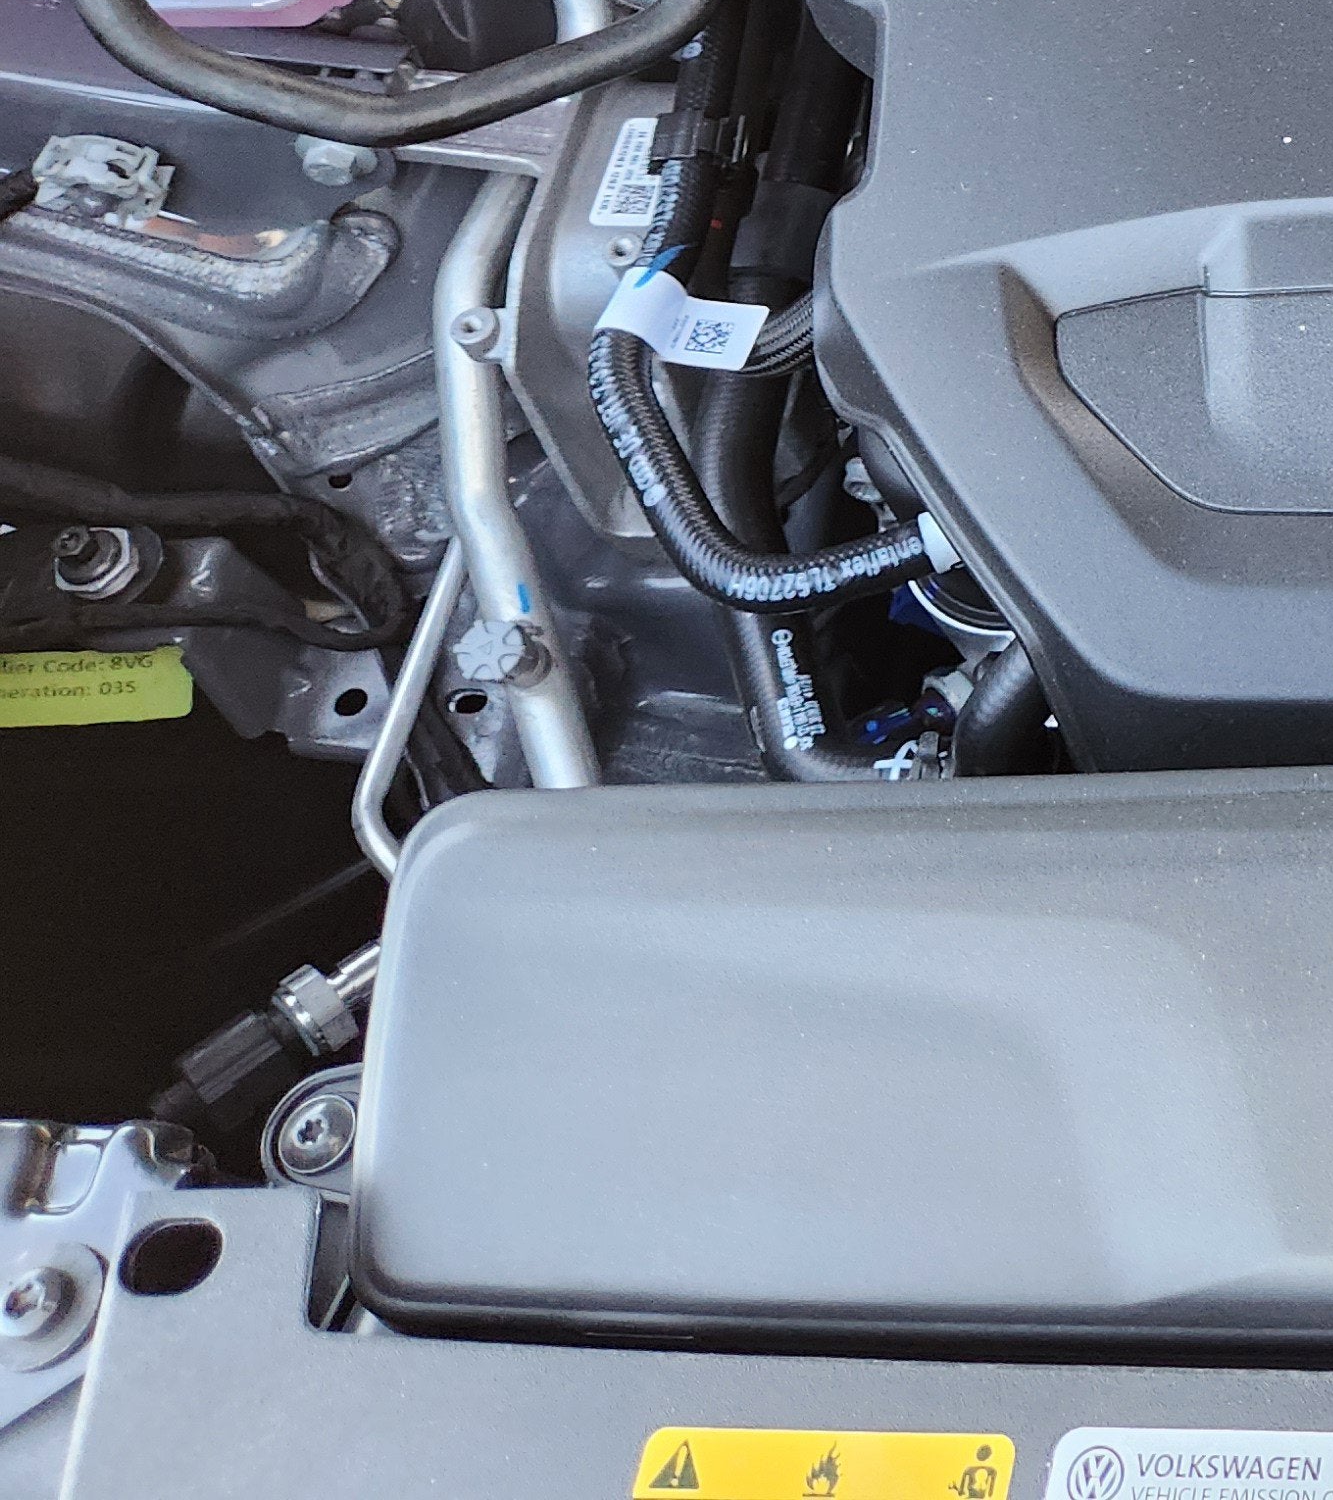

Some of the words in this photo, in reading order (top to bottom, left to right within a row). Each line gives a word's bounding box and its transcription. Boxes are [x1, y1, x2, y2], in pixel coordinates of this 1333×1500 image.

[109, 654, 153, 671] 8VG
[99, 679, 137, 696] 035
[1137, 1453, 1323, 1482] VOLKSWAGEN
